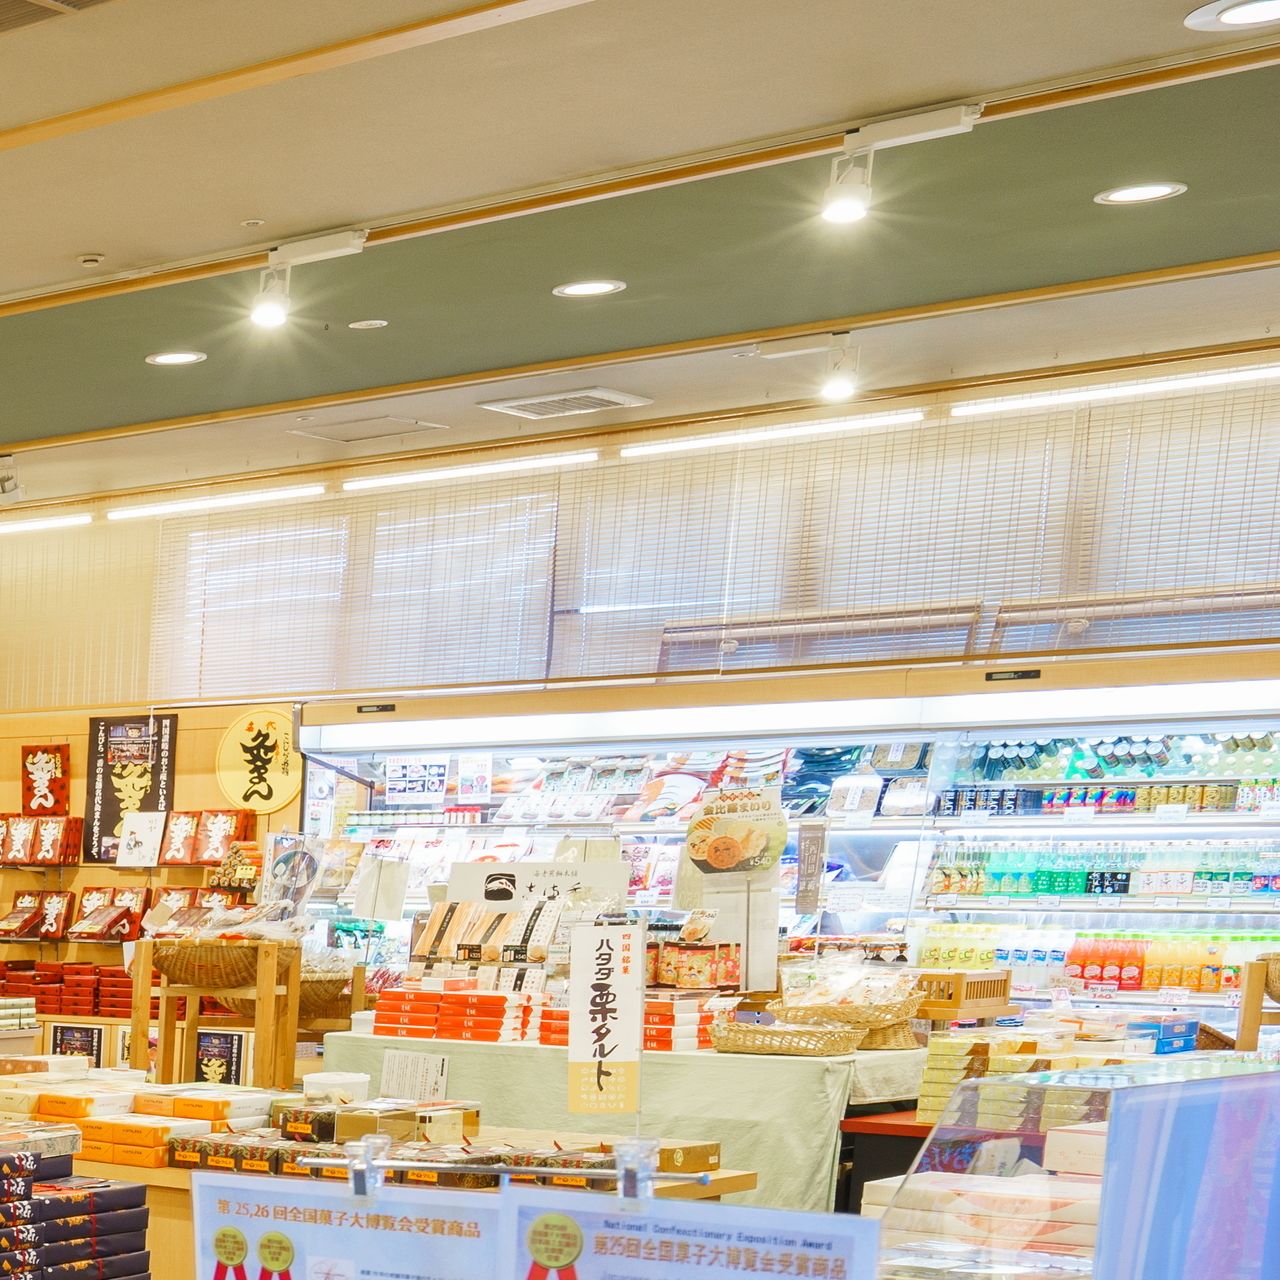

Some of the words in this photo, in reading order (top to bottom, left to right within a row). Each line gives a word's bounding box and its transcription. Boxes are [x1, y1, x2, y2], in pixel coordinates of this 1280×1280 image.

[944, 789, 957, 815] BLACK
[1005, 789, 1017, 815] BLACK
[749, 855, 772, 867] ¥540
[621, 932, 632, 975] 四国銘菓
[588, 937, 620, 1092] ハタダ栗タルト
[235, 1202, 270, 1219] 25,26
